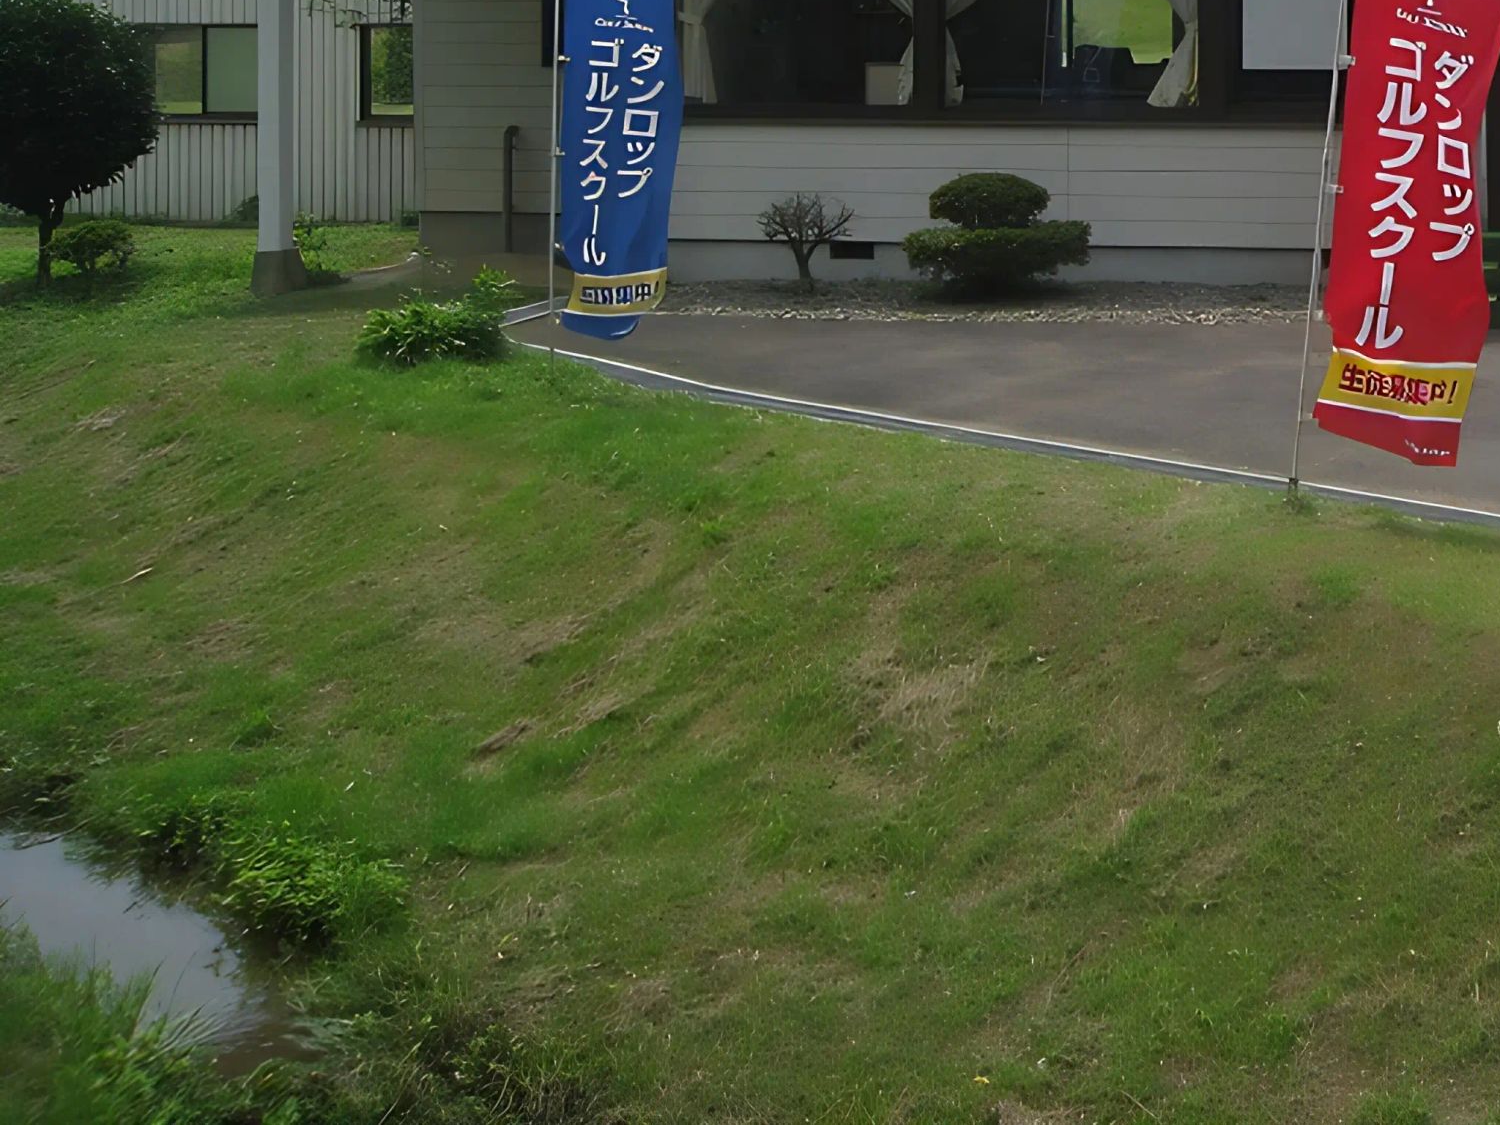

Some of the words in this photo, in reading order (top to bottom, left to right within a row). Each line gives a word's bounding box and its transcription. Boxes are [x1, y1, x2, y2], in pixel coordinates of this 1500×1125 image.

[579, 38, 625, 267] ゴルフスクール
[617, 43, 664, 199] ダンロップ
[1355, 37, 1427, 350] ゴルフスクール
[1431, 49, 1474, 262] ダンロップ
